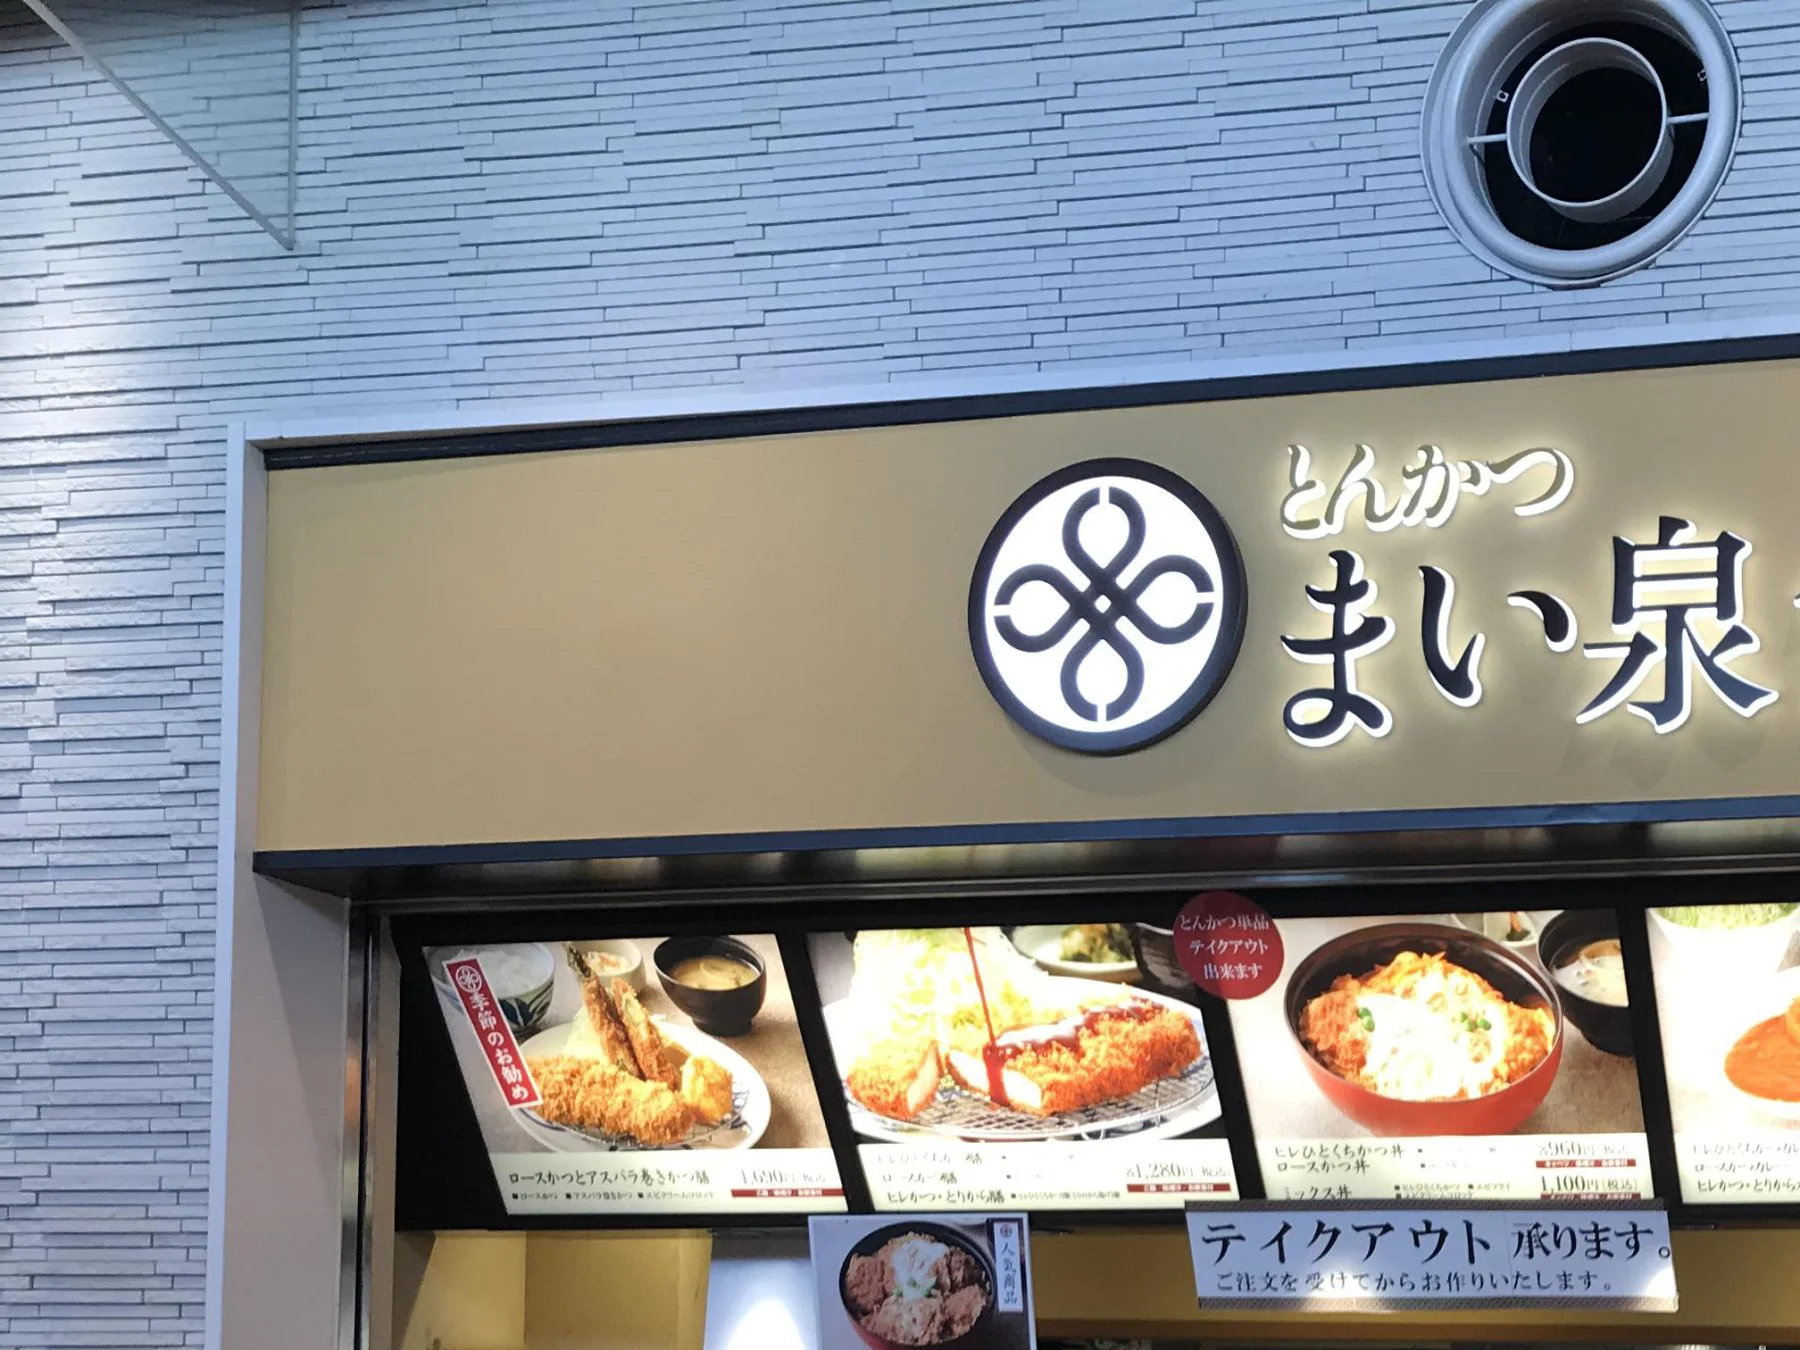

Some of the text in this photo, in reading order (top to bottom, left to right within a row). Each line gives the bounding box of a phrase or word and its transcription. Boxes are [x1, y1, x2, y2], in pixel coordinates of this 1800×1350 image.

[1280, 441, 1574, 538] とんかつ
[1190, 939, 1269, 956] テイクアウト
[1203, 963, 1263, 980] 出来ます
[1216, 1270, 1613, 1293] ご注文を受けてからお作りいたします。
